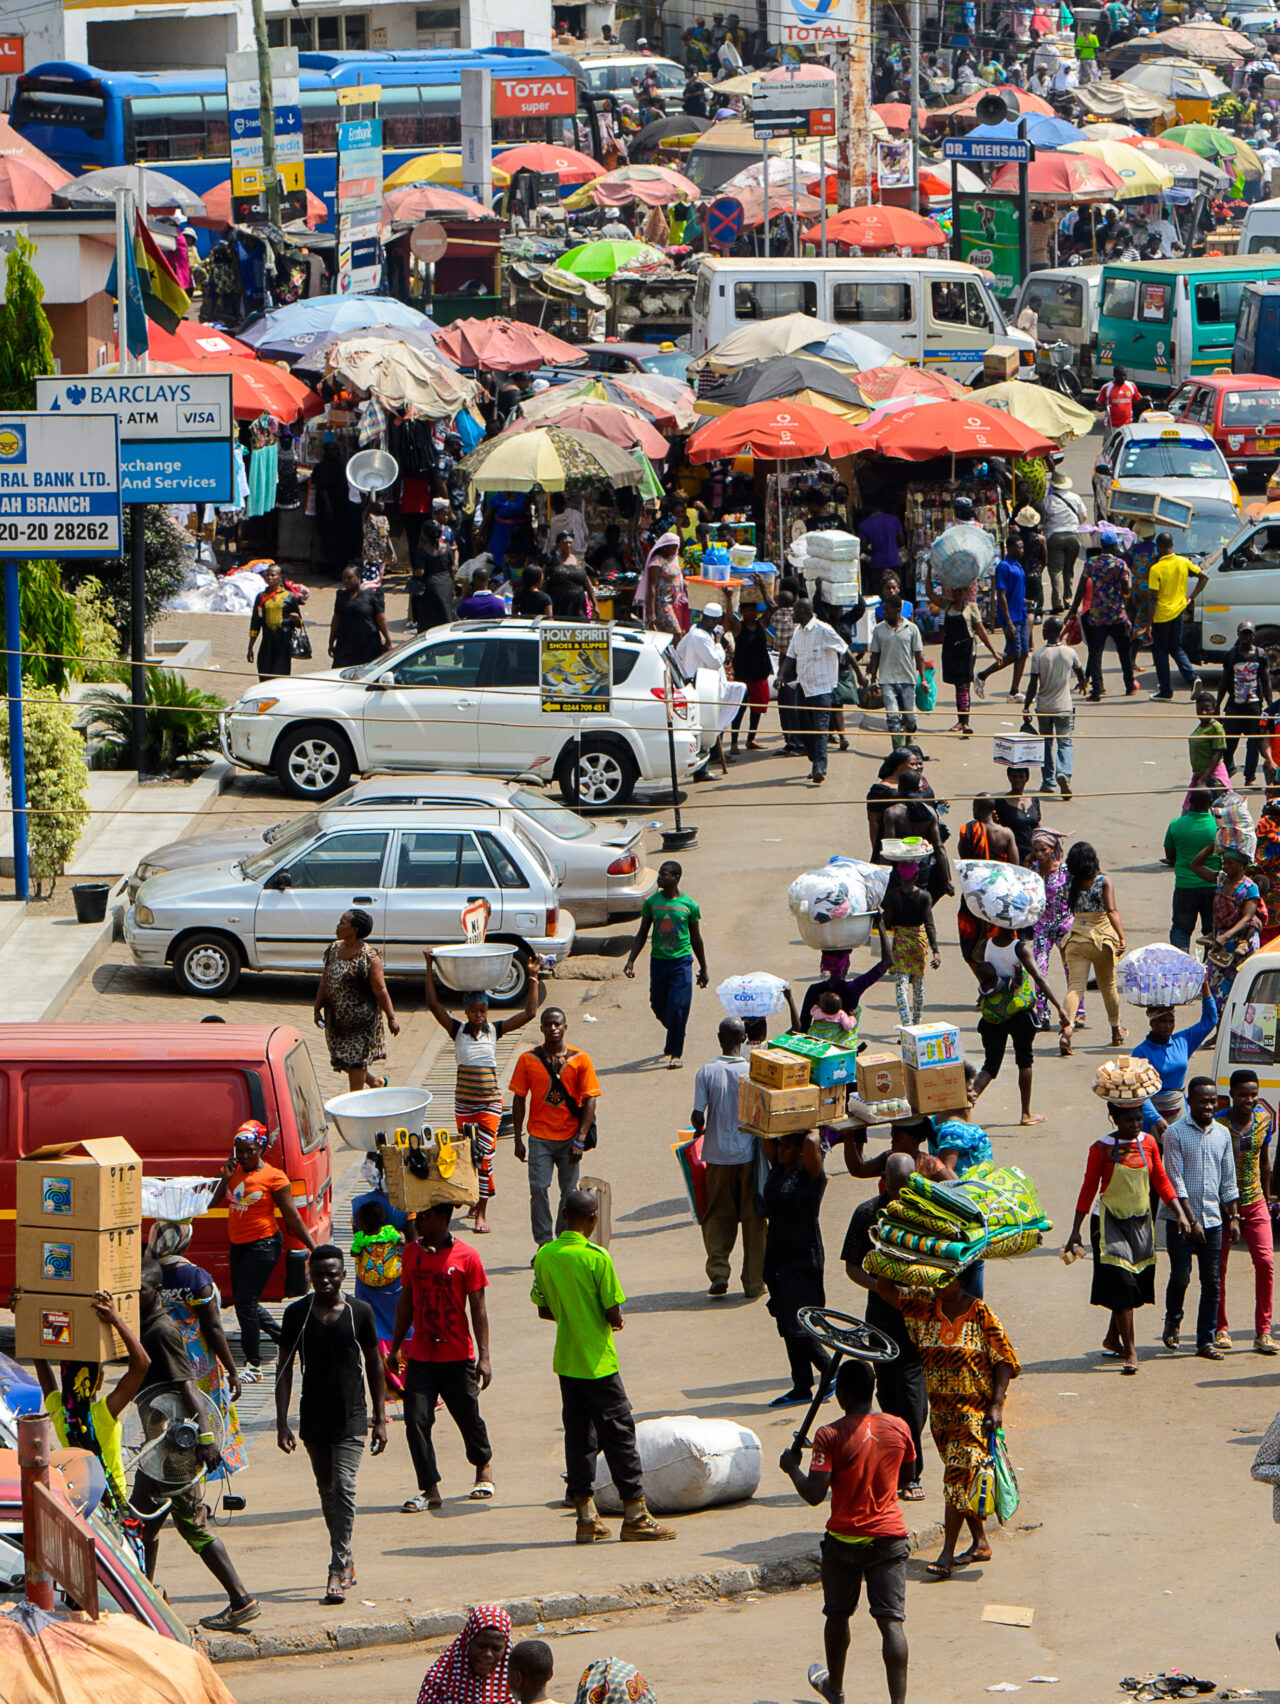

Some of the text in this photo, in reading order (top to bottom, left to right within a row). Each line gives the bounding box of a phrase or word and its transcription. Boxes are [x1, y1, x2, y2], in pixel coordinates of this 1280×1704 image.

[784, 25, 848, 41] TOTAL
[501, 81, 569, 98] TOTAL
[521, 102, 550, 114] super
[945, 143, 1026, 158] DR. MENSAH
[90, 385, 191, 403] BARCLAYS
[127, 412, 215, 424] ATM VISA
[1, 472, 111, 487] RAL BANK LTD.
[122, 477, 217, 489] And Services
[26, 497, 91, 513] BRANCH
[0, 522, 109, 541] 20-20 28262
[542, 629, 608, 641] HOLY SPIRIT
[734, 993, 756, 1002] COOL
